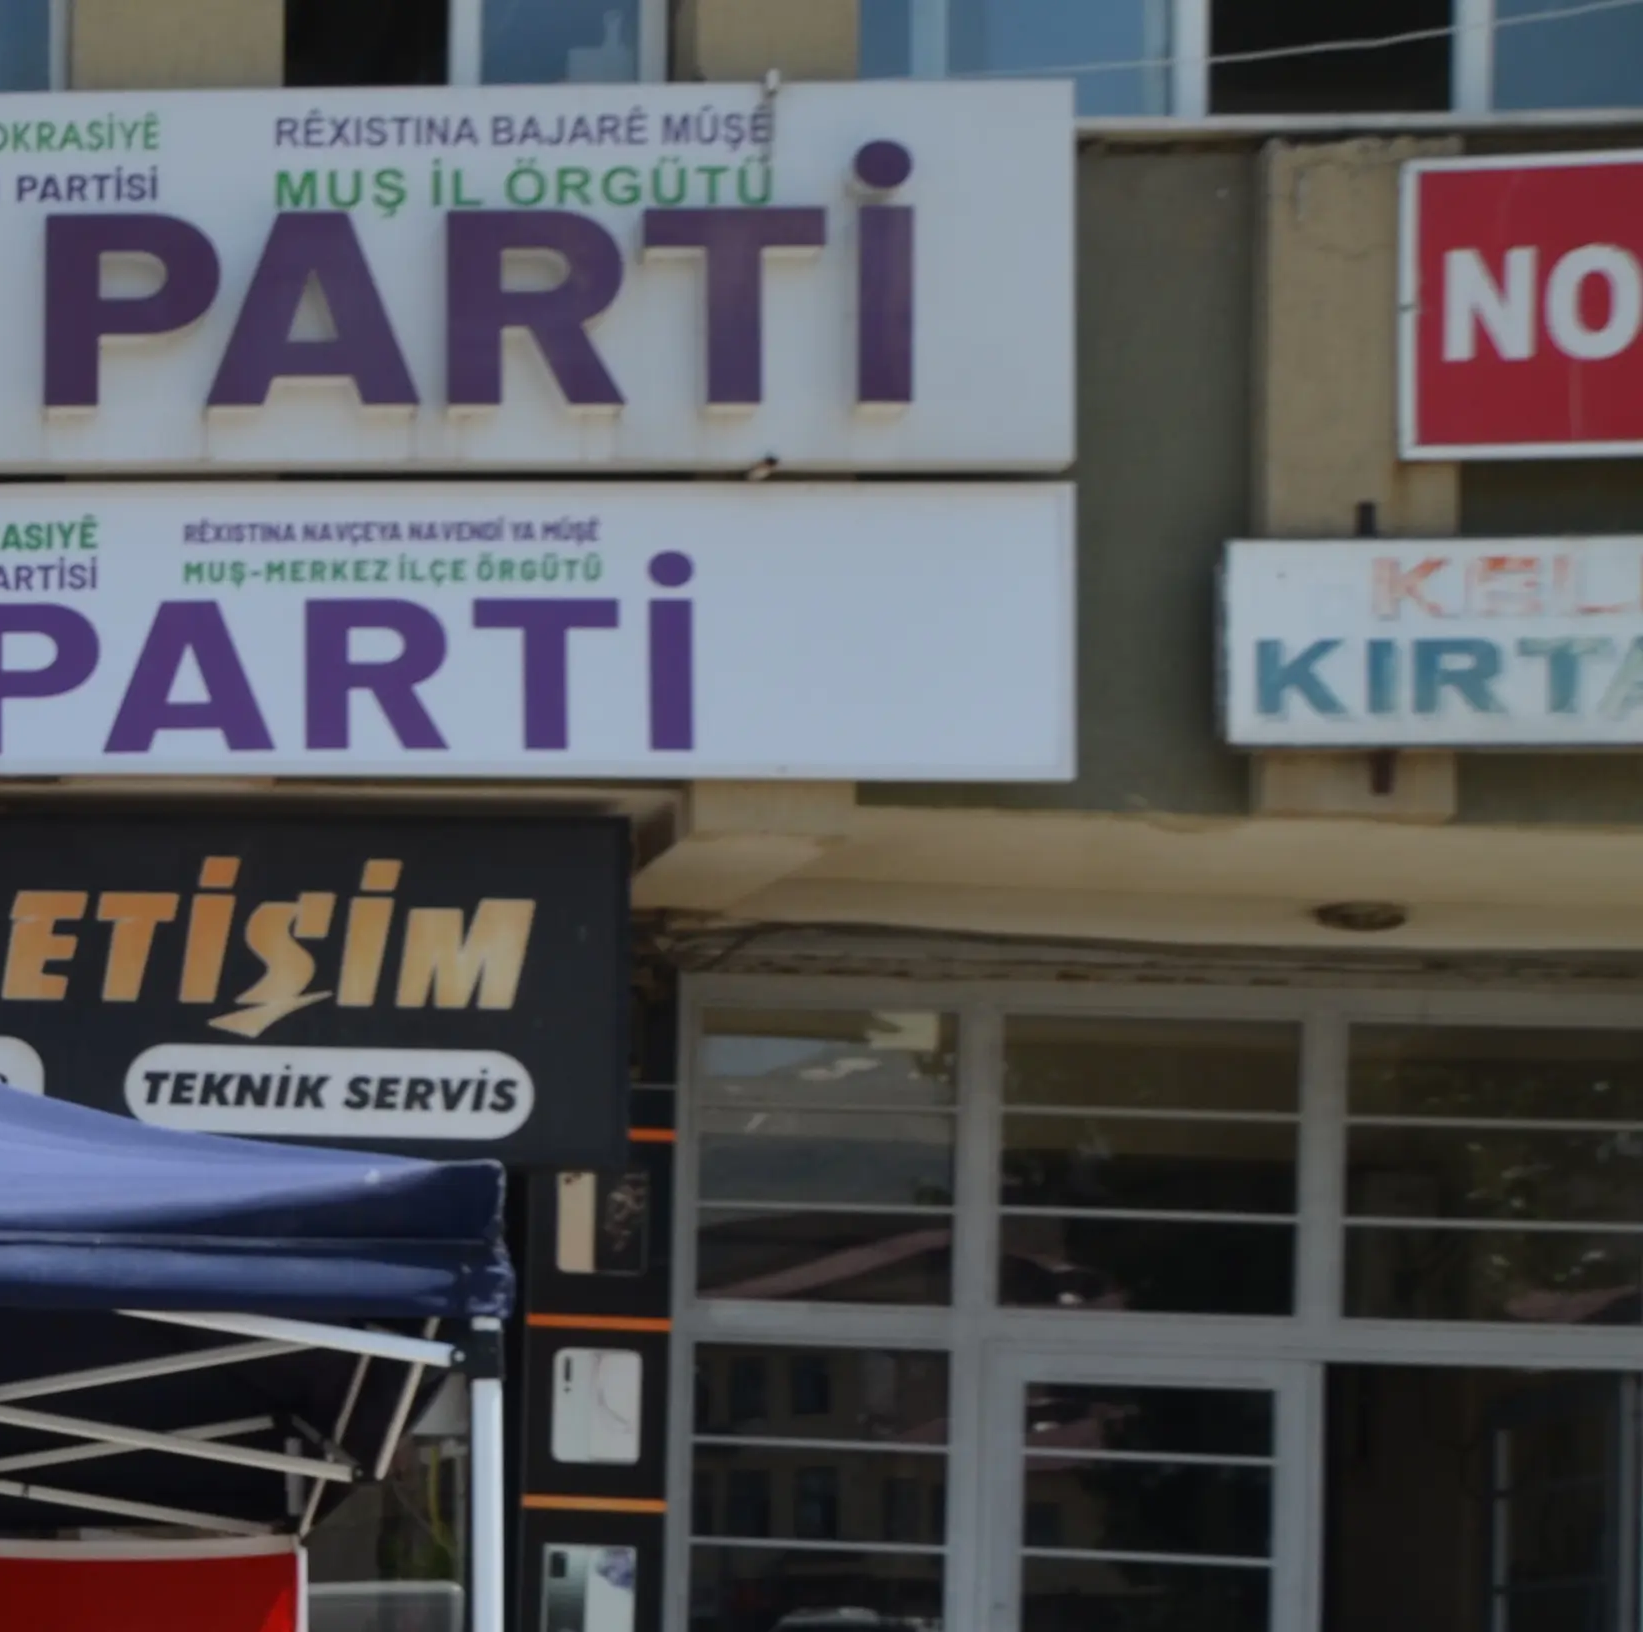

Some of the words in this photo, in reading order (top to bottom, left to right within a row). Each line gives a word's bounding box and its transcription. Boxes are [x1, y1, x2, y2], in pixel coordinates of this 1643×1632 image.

[275, 109, 478, 147] RÊXISTINA
[490, 107, 649, 147] BAJARÊ
[16, 165, 159, 202] PARTİSİ
[275, 166, 407, 218] MUŞ
[431, 158, 484, 207] İL
[504, 157, 774, 207] ÖRGÜTÜ
[43, 139, 914, 408] PARTİ
[183, 518, 296, 544] RÊXISTINA
[302, 521, 402, 547] NAVÇEYA
[510, 521, 535, 541] YA
[183, 558, 389, 587] MUŞ-MERKEZ
[398, 554, 467, 587] İLÇE
[476, 552, 603, 583] ÖRGÜTÜ
[1372, 554, 1643, 620] KEL
[143, 1063, 330, 1110] TEKNİK
[344, 1066, 520, 1113] SERVİS
